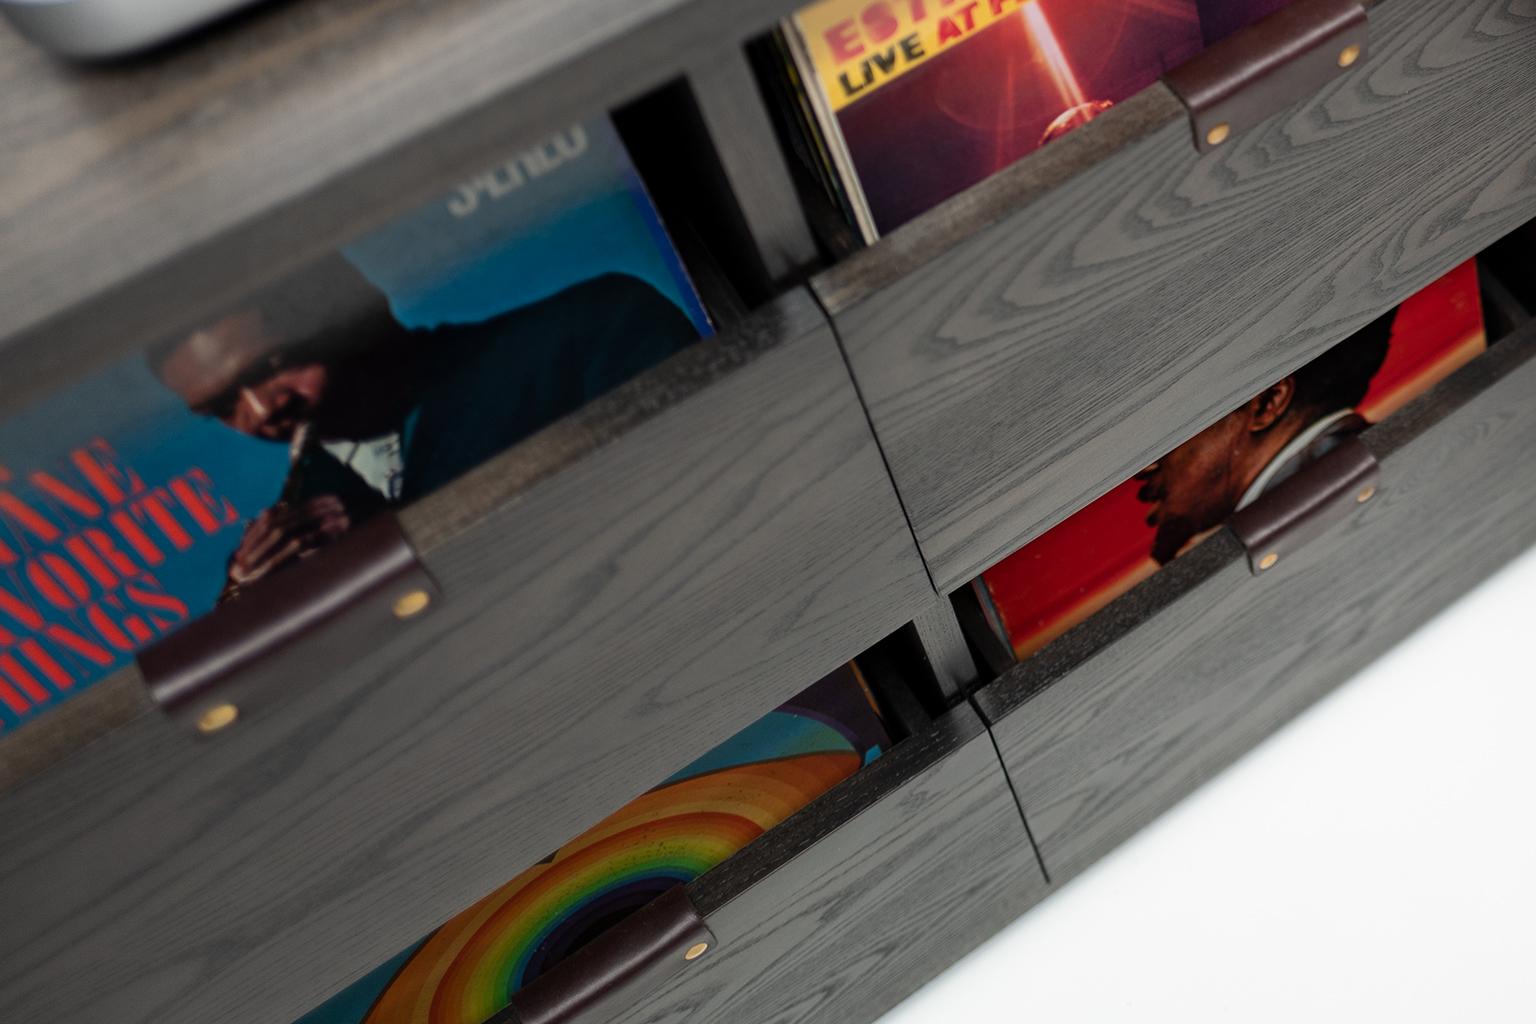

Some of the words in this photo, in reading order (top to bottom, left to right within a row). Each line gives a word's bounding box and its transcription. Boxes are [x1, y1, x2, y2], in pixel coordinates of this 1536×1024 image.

[838, 32, 926, 96] LIVE
[936, 2, 979, 45] AT
[0, 468, 239, 644] VORITE
[0, 572, 190, 722] HINGS
